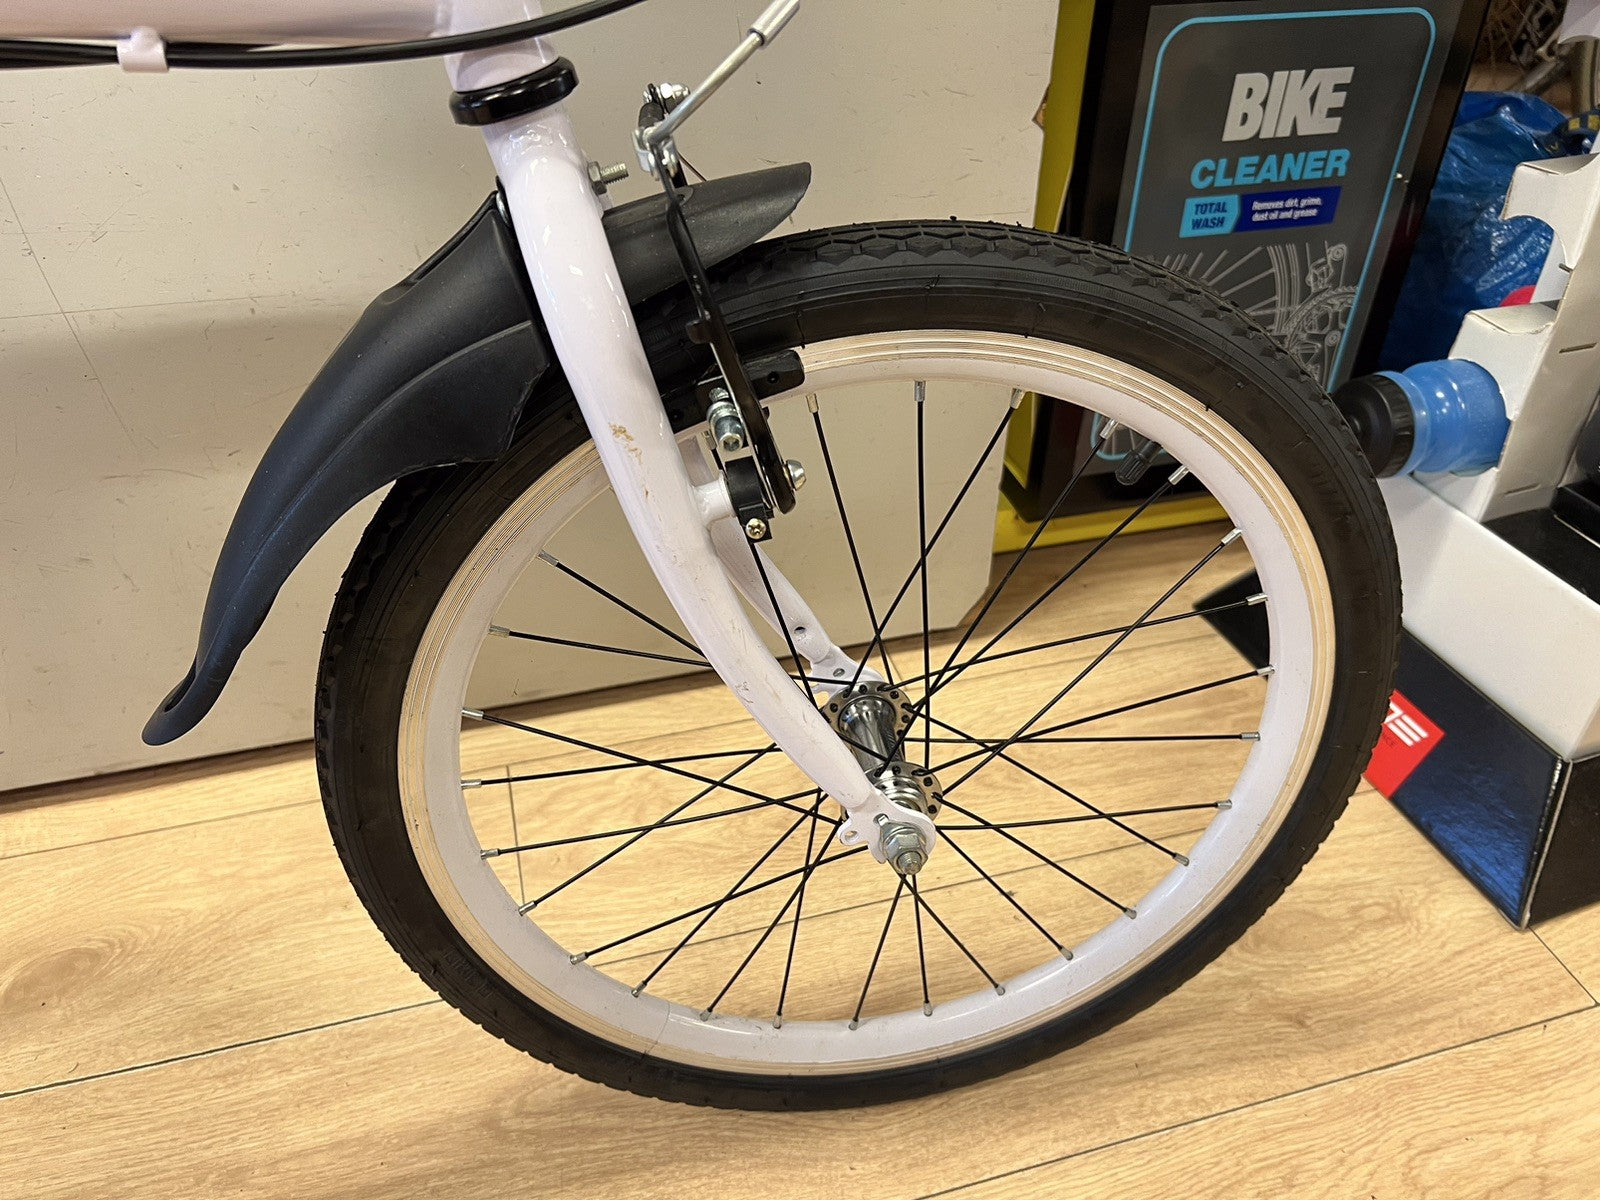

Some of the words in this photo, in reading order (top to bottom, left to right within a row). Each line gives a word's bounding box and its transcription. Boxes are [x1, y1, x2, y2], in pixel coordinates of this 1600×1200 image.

[1222, 66, 1355, 142] BIKE
[1190, 148, 1351, 189] CLEANER
[1194, 201, 1227, 216] TOTAL
[1252, 200, 1284, 211] Removes
[1285, 197, 1300, 208] dirt,
[1252, 209, 1269, 222] dust
[1269, 210, 1278, 219] oil
[1279, 209, 1293, 219] and
[1294, 208, 1318, 219] grease
[1191, 216, 1225, 230] WASH
